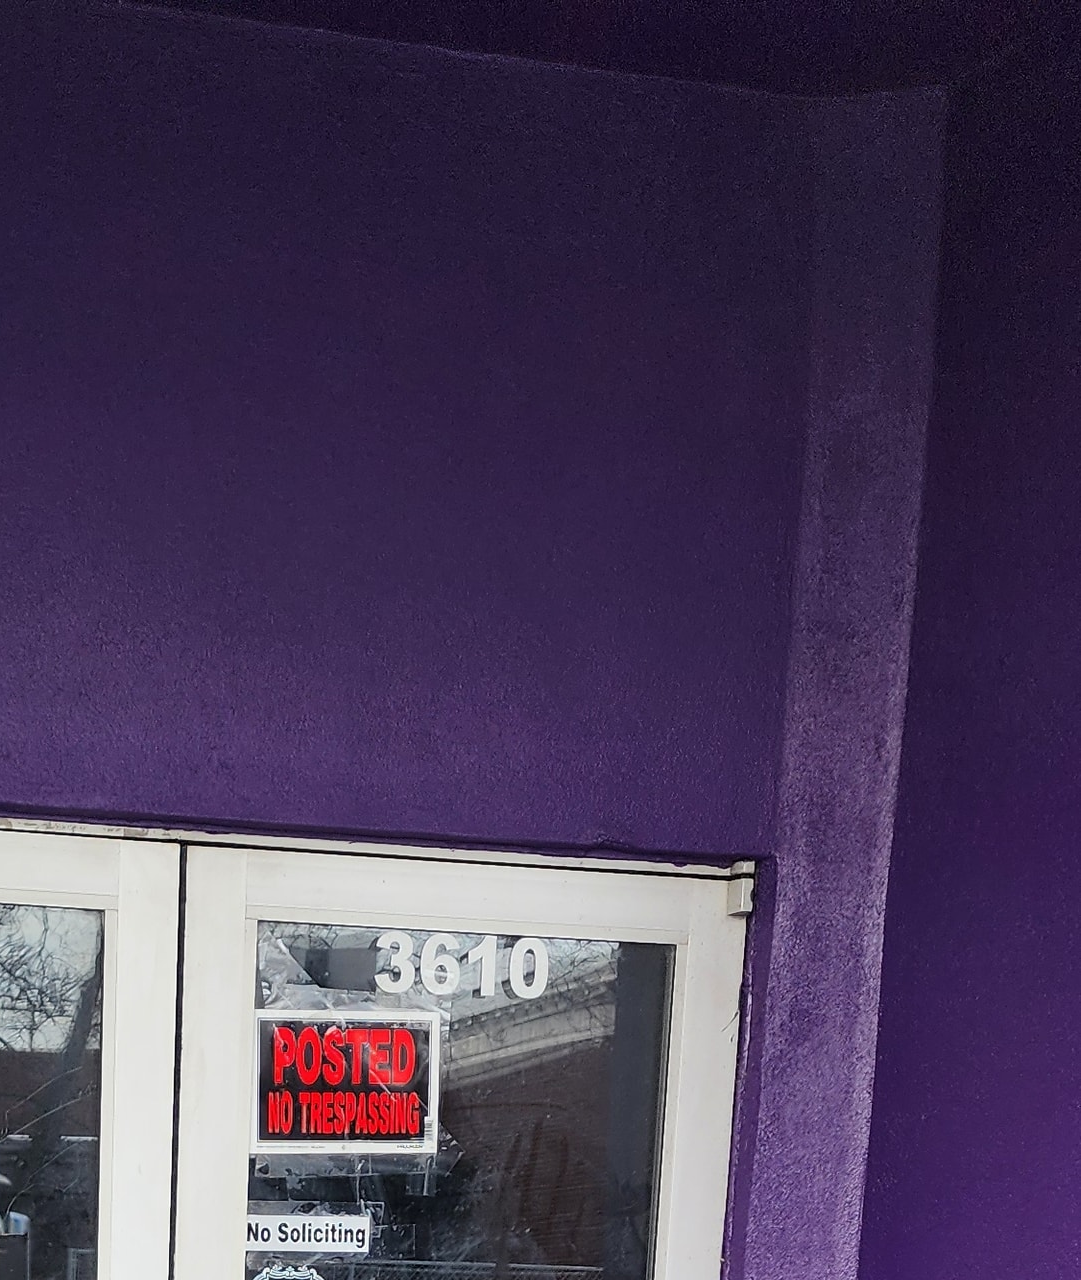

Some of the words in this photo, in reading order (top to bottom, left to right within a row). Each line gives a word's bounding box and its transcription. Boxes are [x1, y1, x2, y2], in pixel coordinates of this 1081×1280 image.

[373, 931, 549, 999] 3610
[273, 1026, 416, 1086] POSTED
[267, 1090, 293, 1135] NO
[299, 1090, 421, 1136] TRESPASSING
[247, 1222, 271, 1243] No
[278, 1222, 366, 1249] Soliciting
